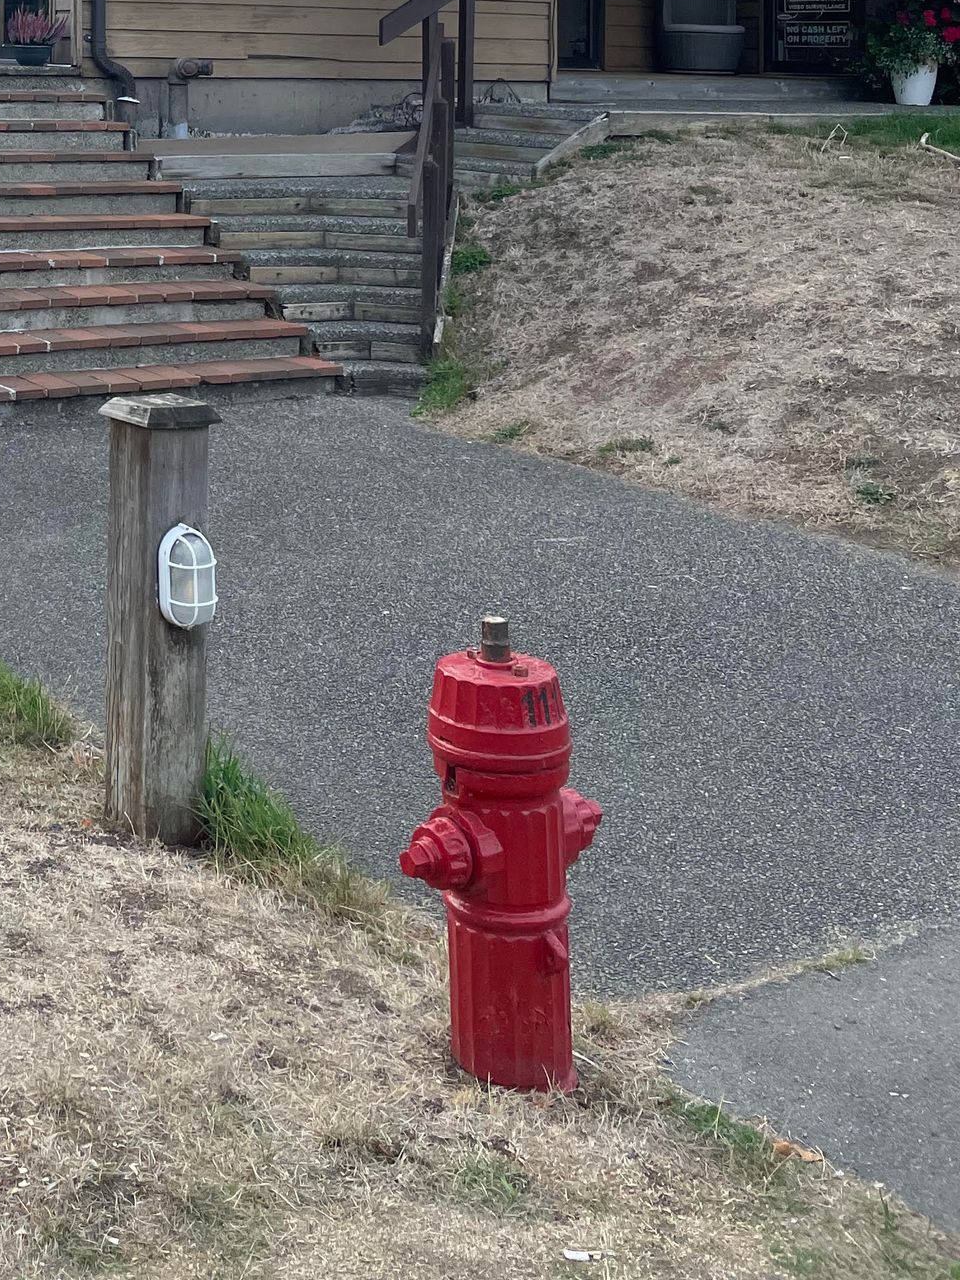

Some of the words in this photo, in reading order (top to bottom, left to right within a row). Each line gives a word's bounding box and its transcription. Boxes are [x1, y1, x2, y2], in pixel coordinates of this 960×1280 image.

[827, 25, 847, 33] LEFT
[787, 35, 799, 43] ON
[801, 35, 847, 43] PROPERTY
